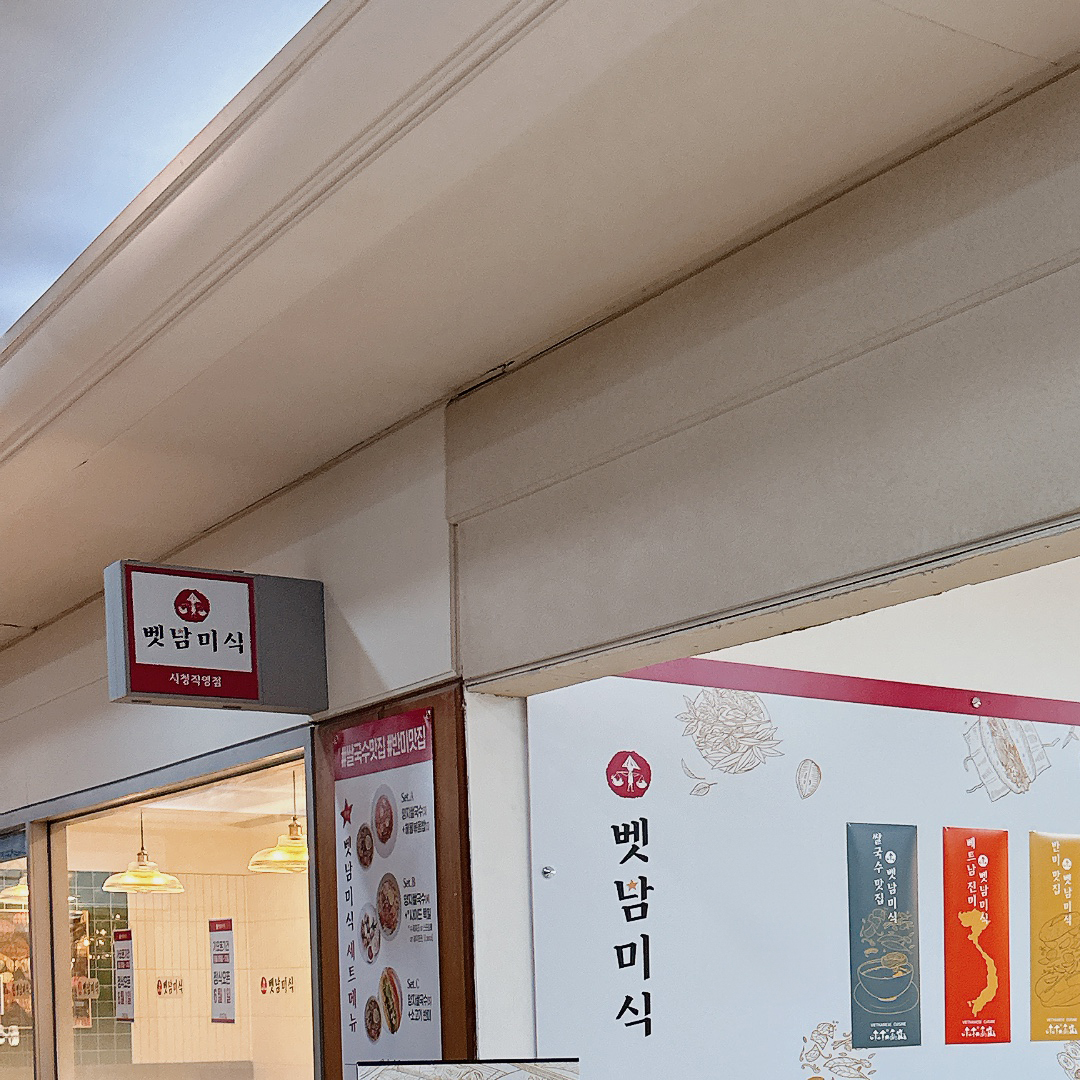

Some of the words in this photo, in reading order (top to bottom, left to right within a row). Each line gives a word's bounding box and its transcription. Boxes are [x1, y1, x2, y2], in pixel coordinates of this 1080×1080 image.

[142, 624, 244, 653] 벳남미식
[169, 673, 222, 687] 시청직영점
[341, 735, 386, 768] #쌀국수맛집
[387, 724, 426, 757] #반미맛집
[872, 832, 884, 874] 쌀국수
[965, 837, 976, 877] 베트남
[1051, 841, 1060, 866] 반미
[343, 835, 354, 931] 벳남미식
[874, 878, 884, 906] 맛집
[886, 867, 898, 924] 벳남미식
[978, 871, 989, 924] 벳남미식
[1051, 869, 1061, 896] 맛집
[1062, 873, 1072, 926] 벳남미식
[610, 816, 655, 1037] 벳남미식
[269, 976, 294, 994] 벳남미식
[346, 940, 357, 1032] 세트메뉴
